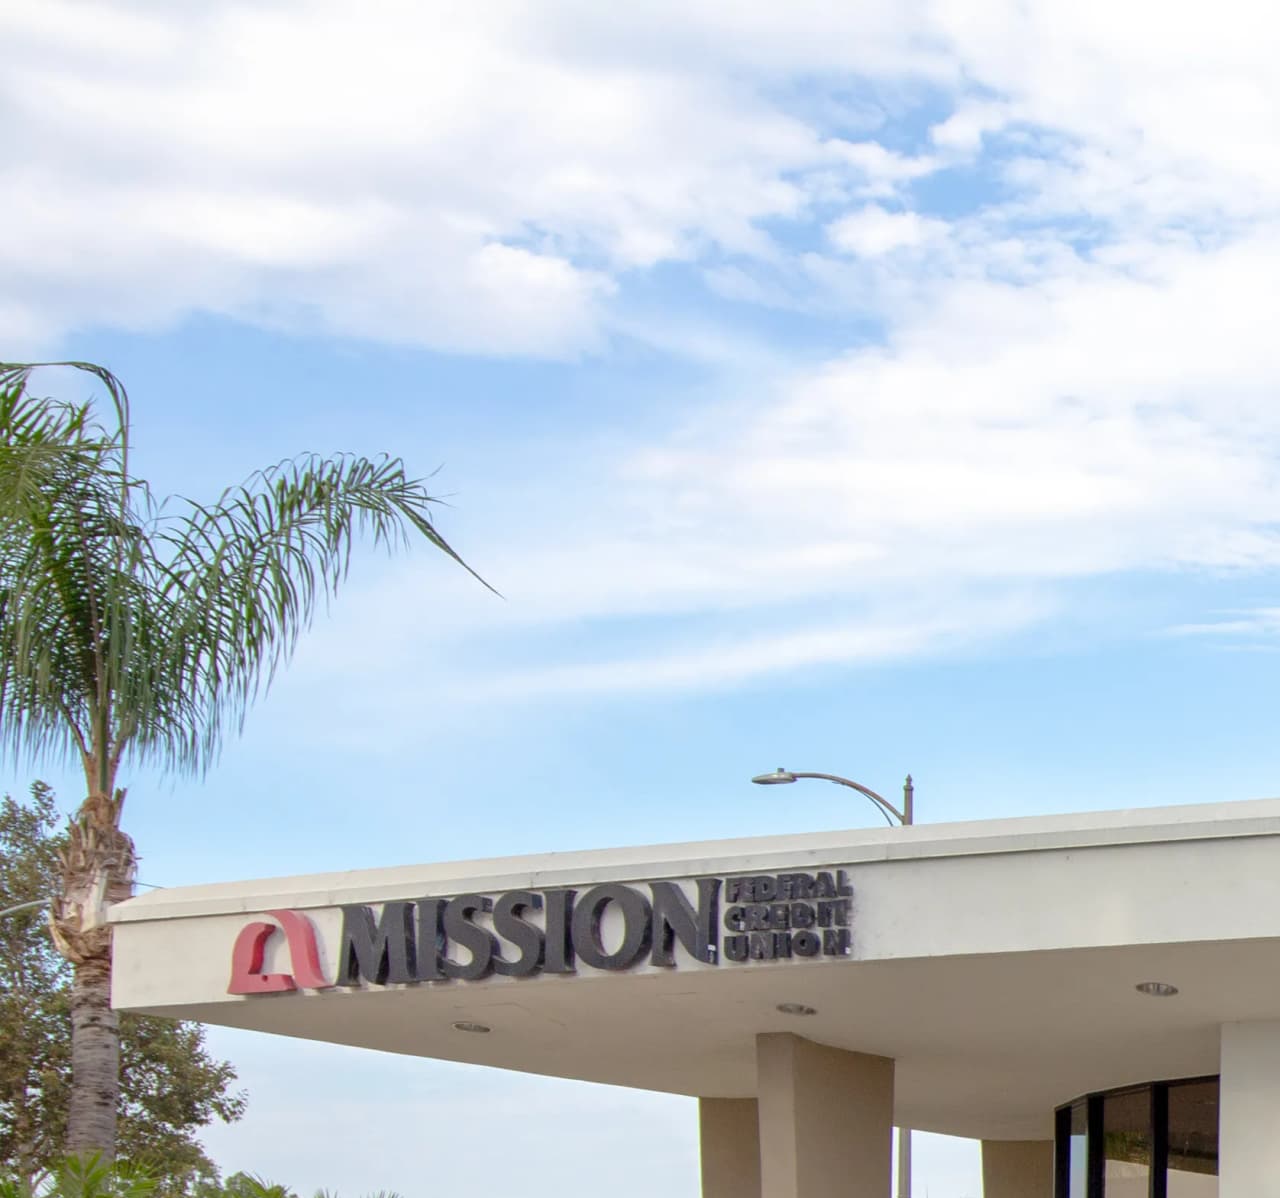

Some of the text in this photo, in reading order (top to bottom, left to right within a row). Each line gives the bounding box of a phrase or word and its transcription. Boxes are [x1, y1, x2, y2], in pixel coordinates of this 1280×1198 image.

[725, 870, 854, 903] FEDERAL
[336, 878, 722, 986] MISSION
[724, 900, 852, 932] CREDIT
[724, 928, 851, 962] UNION
